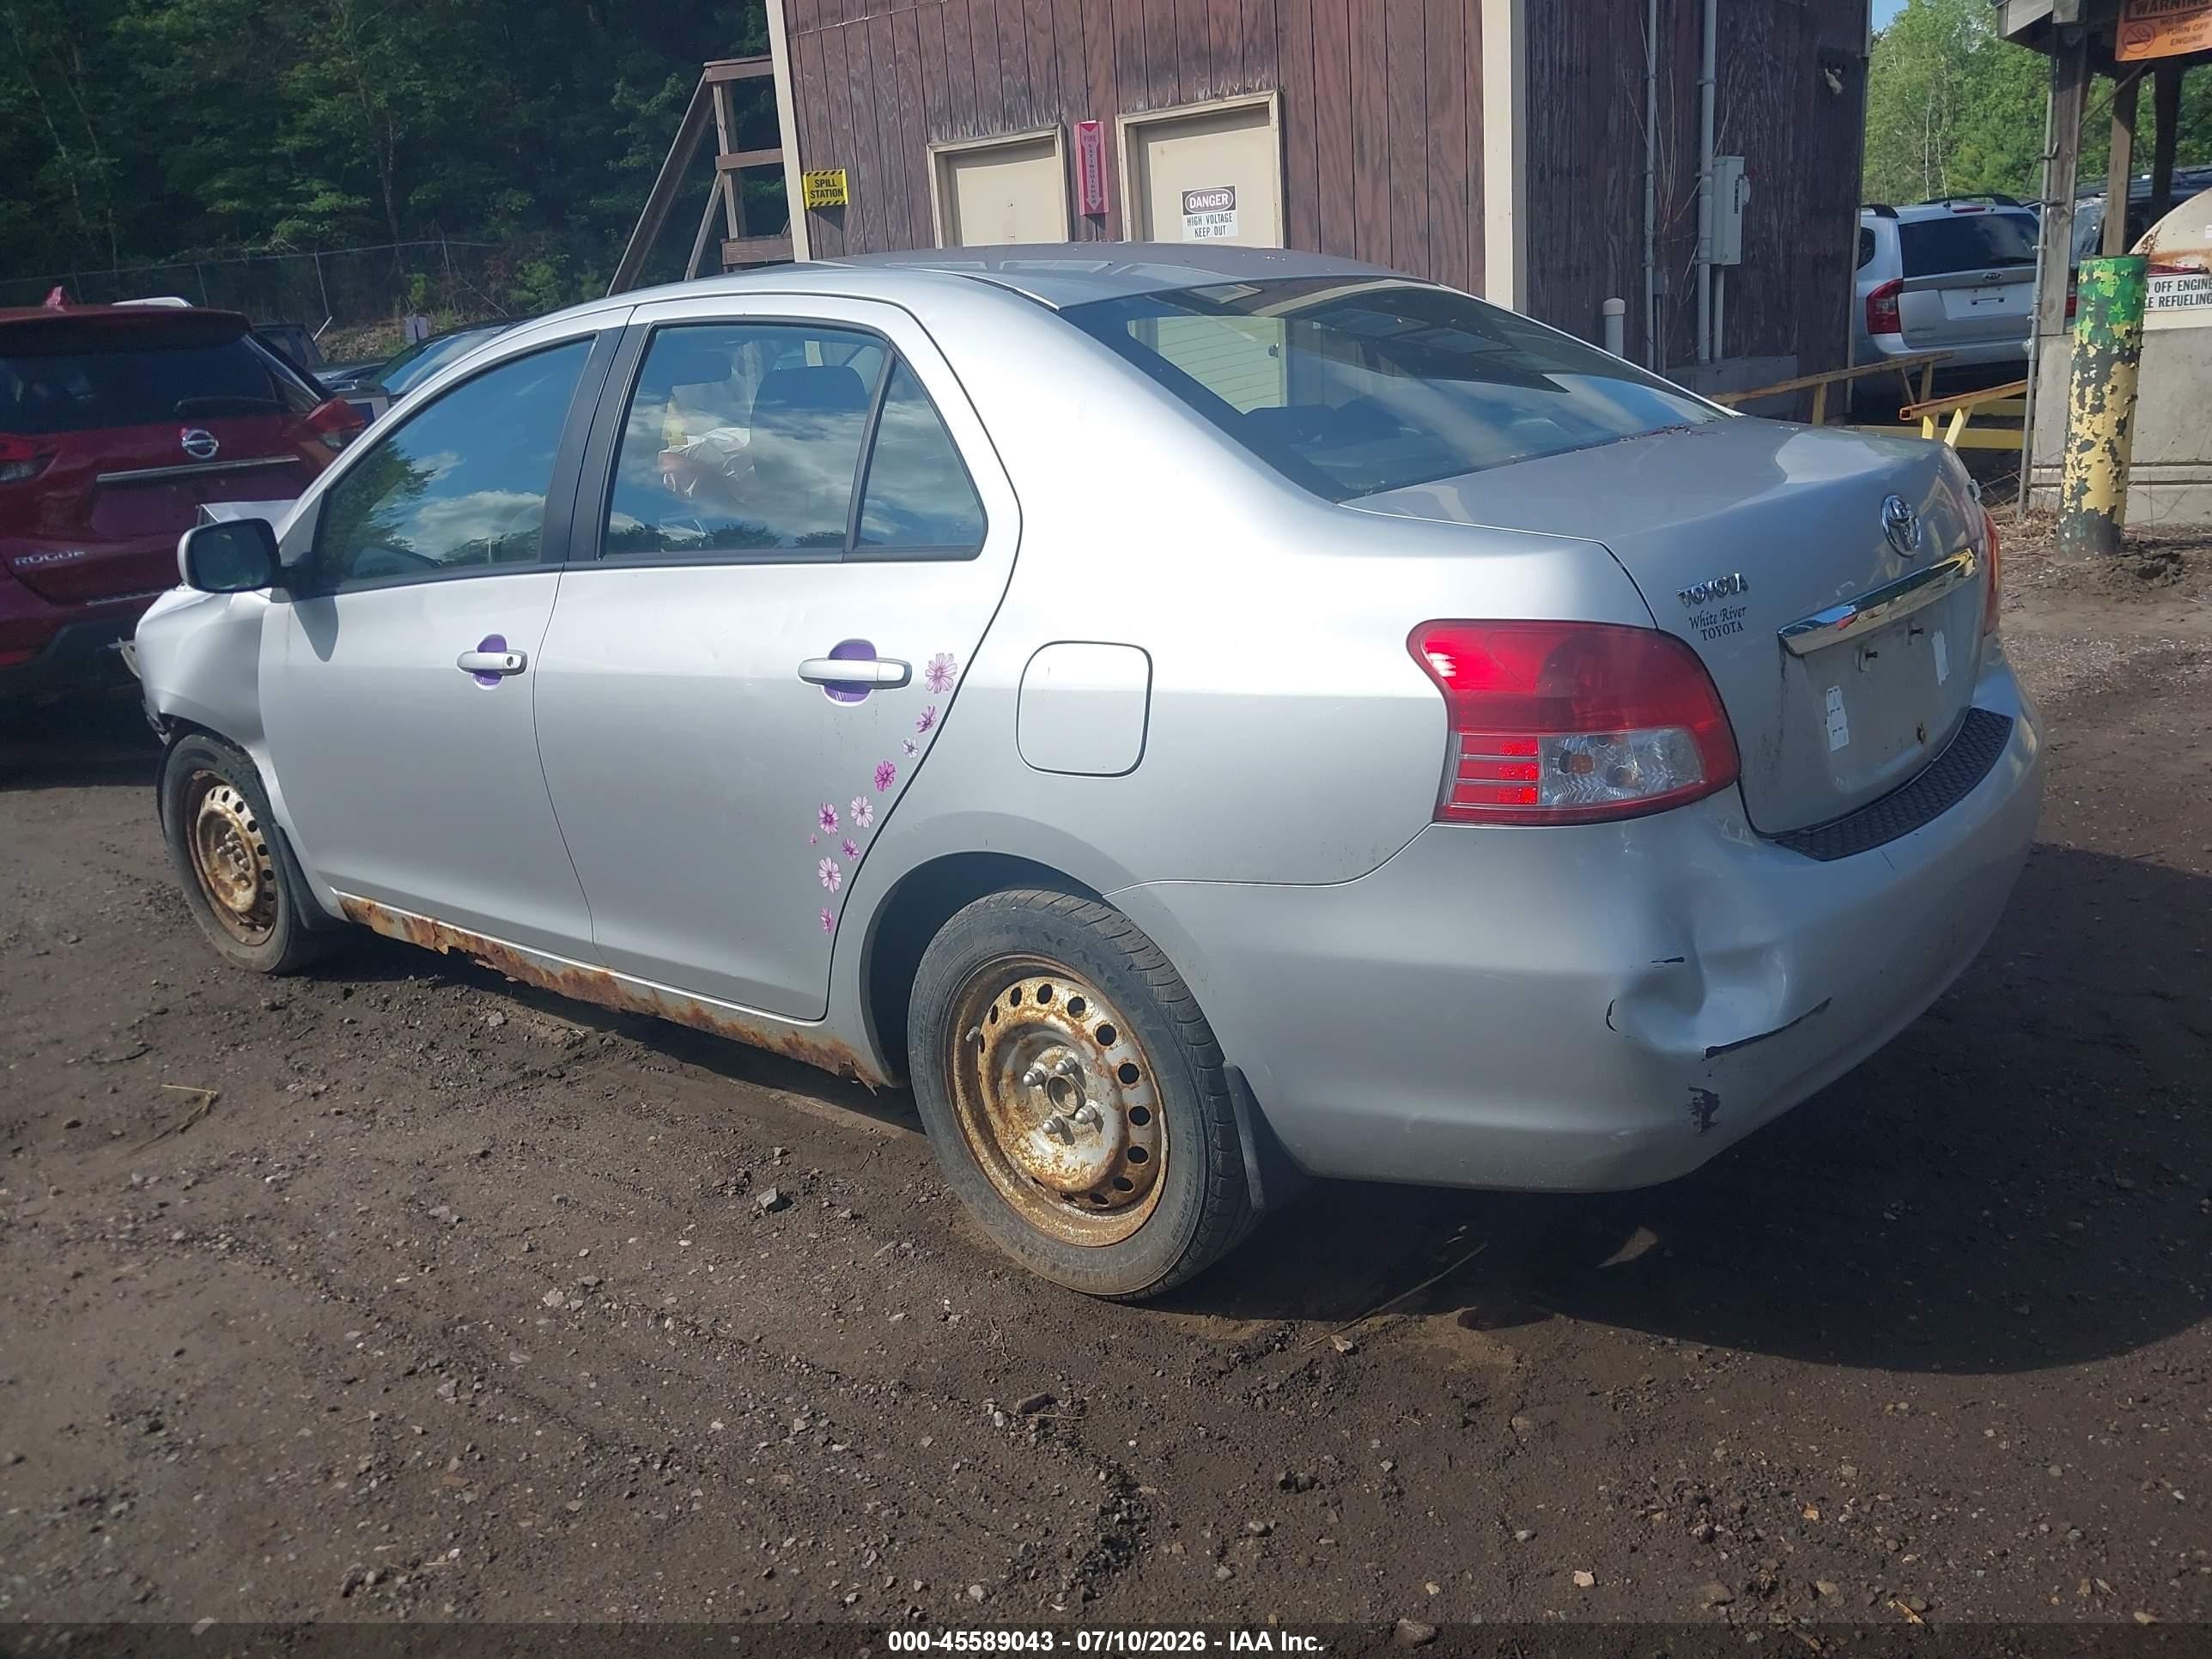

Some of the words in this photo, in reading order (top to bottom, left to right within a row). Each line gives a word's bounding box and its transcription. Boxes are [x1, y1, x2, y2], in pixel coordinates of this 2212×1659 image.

[2177, 10, 2212, 23] SMOK
[2166, 27, 2191, 35] TURN
[2192, 21, 2210, 32] OFF
[2170, 34, 2204, 46] ENGINE
[814, 179, 837, 188] SPILL
[810, 188, 844, 199] STATION
[1189, 193, 1229, 209] DANGER
[1187, 216, 1202, 227] HIGH
[1206, 212, 1233, 225] VOLTAGE
[1194, 227, 1211, 239] KEEP
[1213, 225, 1226, 236] OUT
[2154, 281, 2173, 294] OFF
[2158, 293, 2212, 307] REFUELING
[1676, 573, 1749, 609] TOYOTA
[1688, 610, 1718, 630] White
[1720, 605, 1747, 623] River
[1700, 621, 1744, 641] TOYOTA
